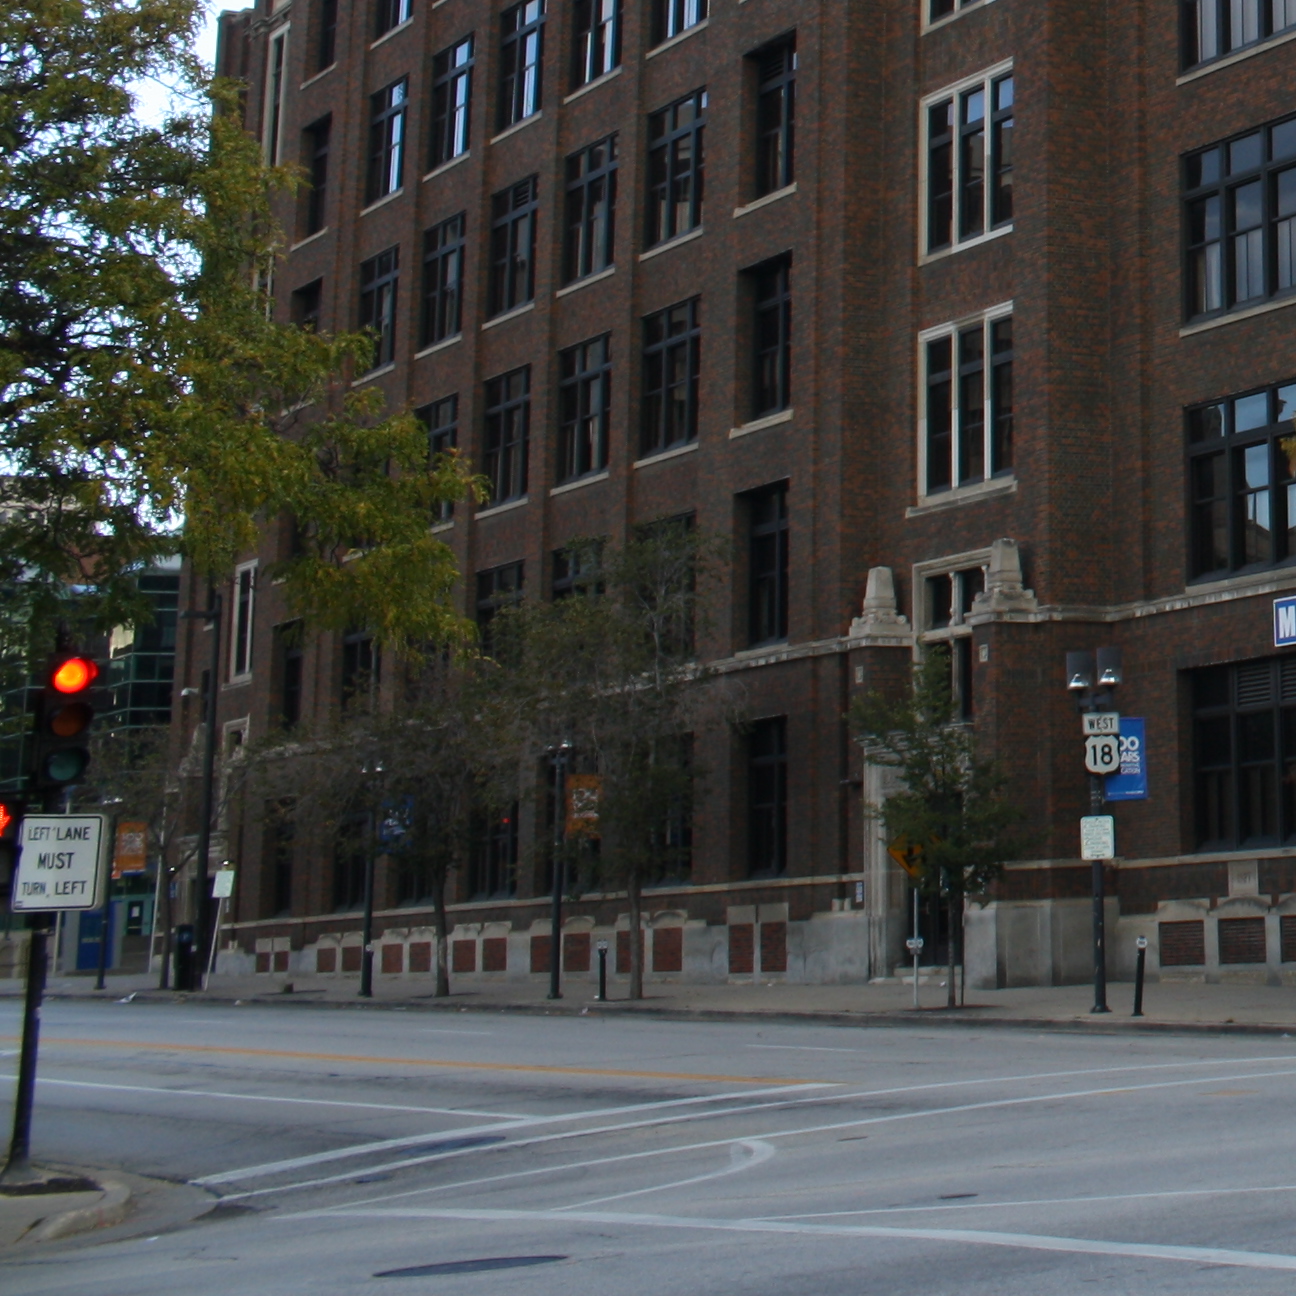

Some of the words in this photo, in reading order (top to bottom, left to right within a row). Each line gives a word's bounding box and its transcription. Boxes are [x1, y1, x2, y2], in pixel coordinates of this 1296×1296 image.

[1278, 605, 1296, 639] M
[1088, 717, 1113, 729] WEST
[1091, 744, 1113, 766] 18
[28, 826, 50, 841] LEFT
[56, 826, 91, 841] LANE
[37, 852, 75, 869] MUST
[22, 882, 46, 896] TURN
[55, 880, 87, 895] LEFT
